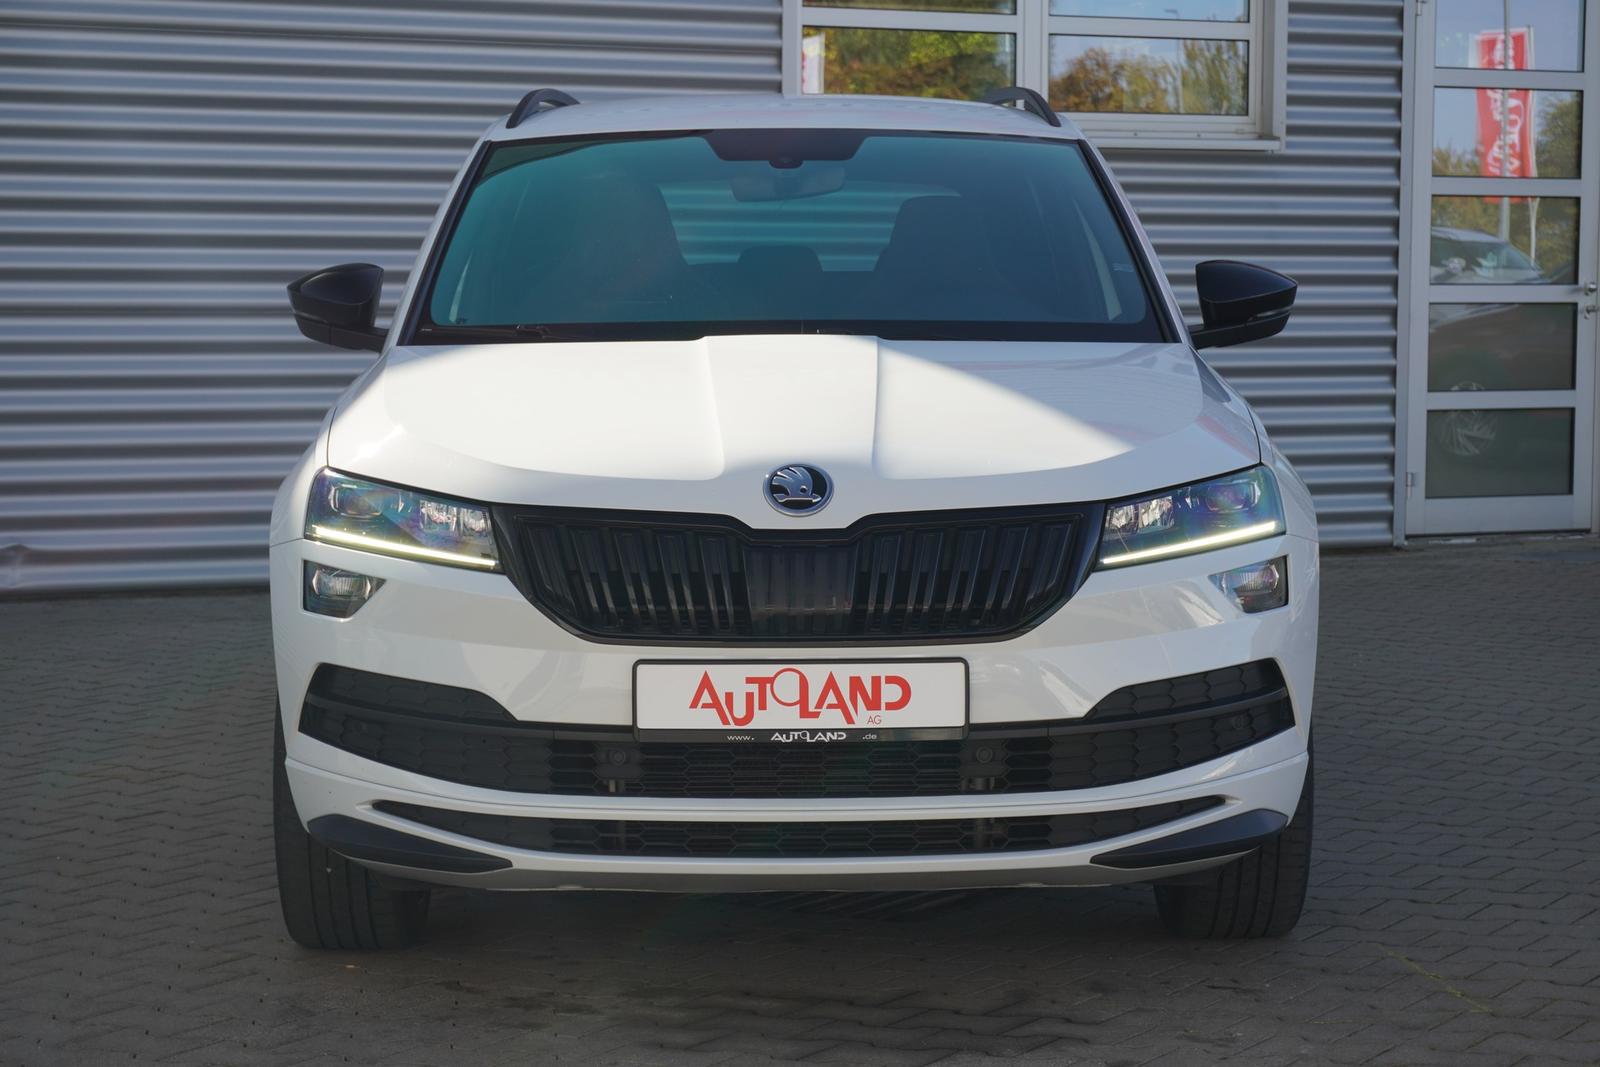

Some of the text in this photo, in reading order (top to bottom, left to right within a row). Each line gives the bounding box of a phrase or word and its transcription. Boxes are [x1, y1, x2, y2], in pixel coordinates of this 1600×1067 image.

[689, 667, 912, 727] AUTOLAND
[866, 715, 882, 725] AG
[771, 730, 847, 743] AUTOLAND
